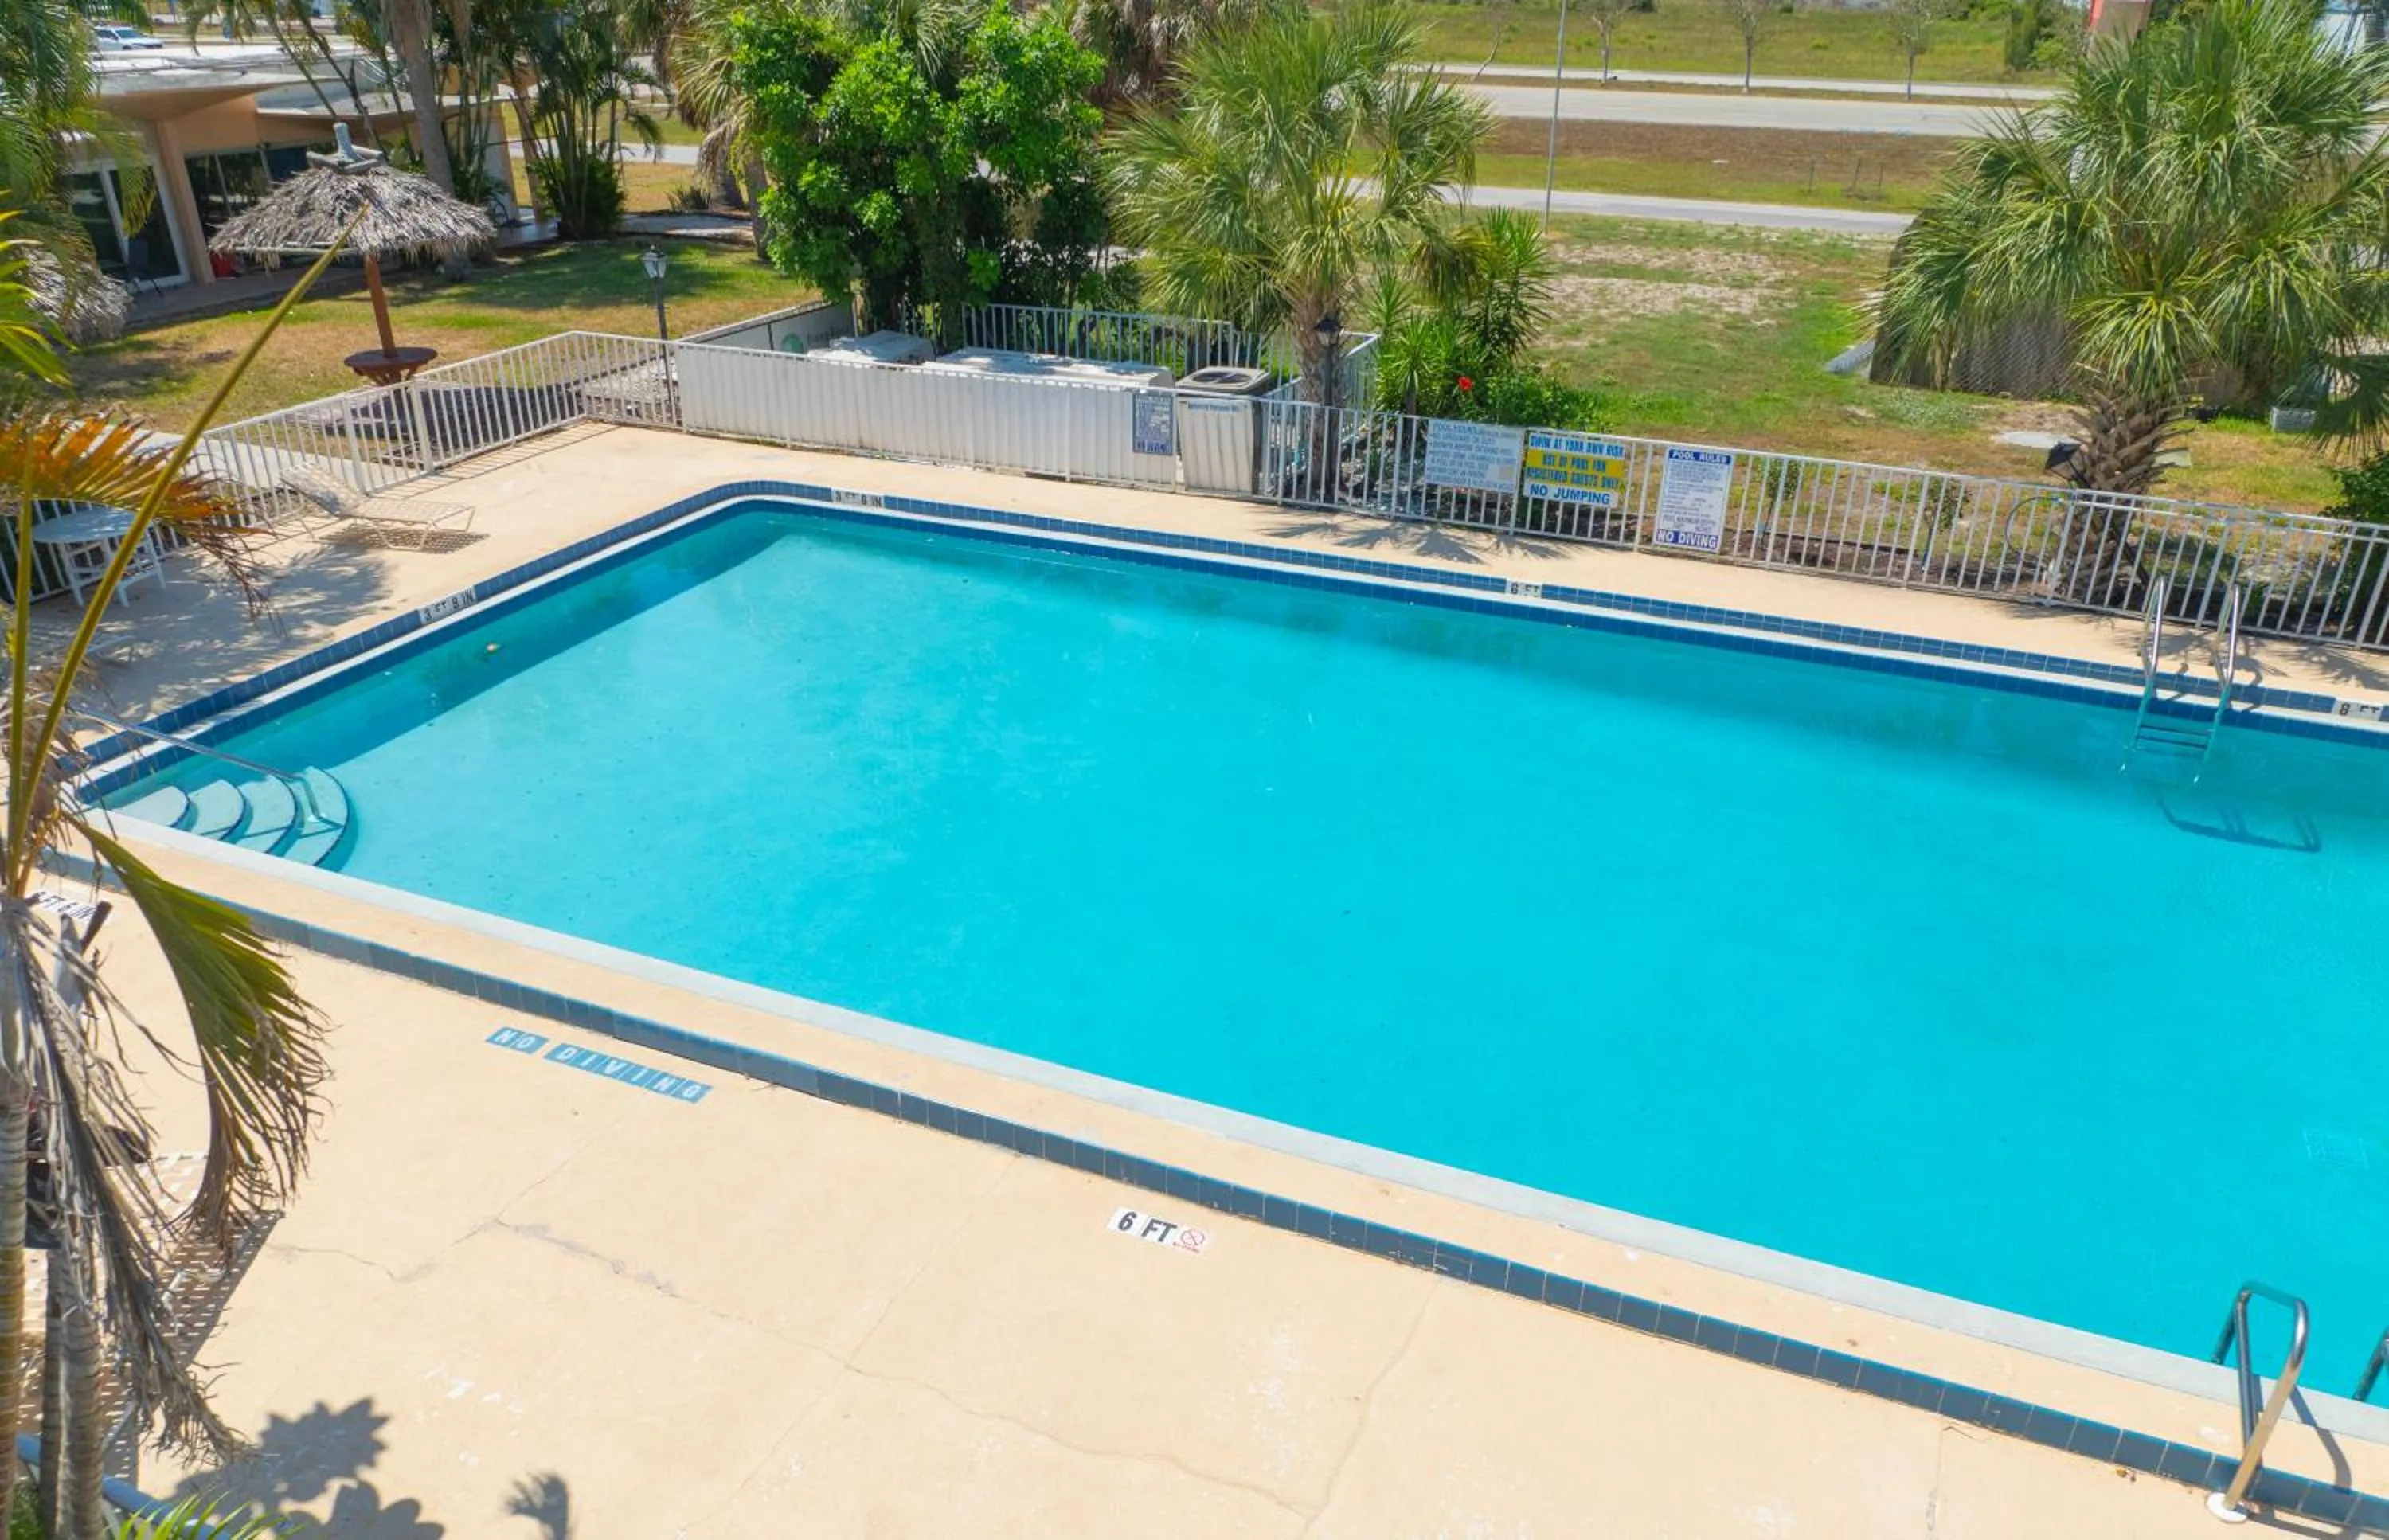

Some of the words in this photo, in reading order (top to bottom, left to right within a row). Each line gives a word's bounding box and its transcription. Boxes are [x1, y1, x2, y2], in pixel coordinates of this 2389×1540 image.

[1530, 435, 1551, 448] SWIM
[1554, 437, 1562, 449] AT
[1566, 439, 1584, 451] YOUR
[1586, 442, 1605, 454] OWN
[1606, 444, 1624, 458] RISK
[1672, 449, 1695, 460] POOL
[1699, 452, 1727, 463] RULES
[1530, 483, 1548, 496] NO
[1554, 487, 1610, 504] JUMPING
[1657, 529, 1674, 543] NO
[1678, 532, 1717, 549] DIVING
[462, 589, 473, 605] IN
[2339, 702, 2350, 716] 8
[2360, 705, 2380, 714] FT
[491, 1028, 538, 1050] NO
[554, 1047, 704, 1098] DIVING
[1117, 1211, 1138, 1231] 6
[1140, 1218, 1178, 1243] FT
